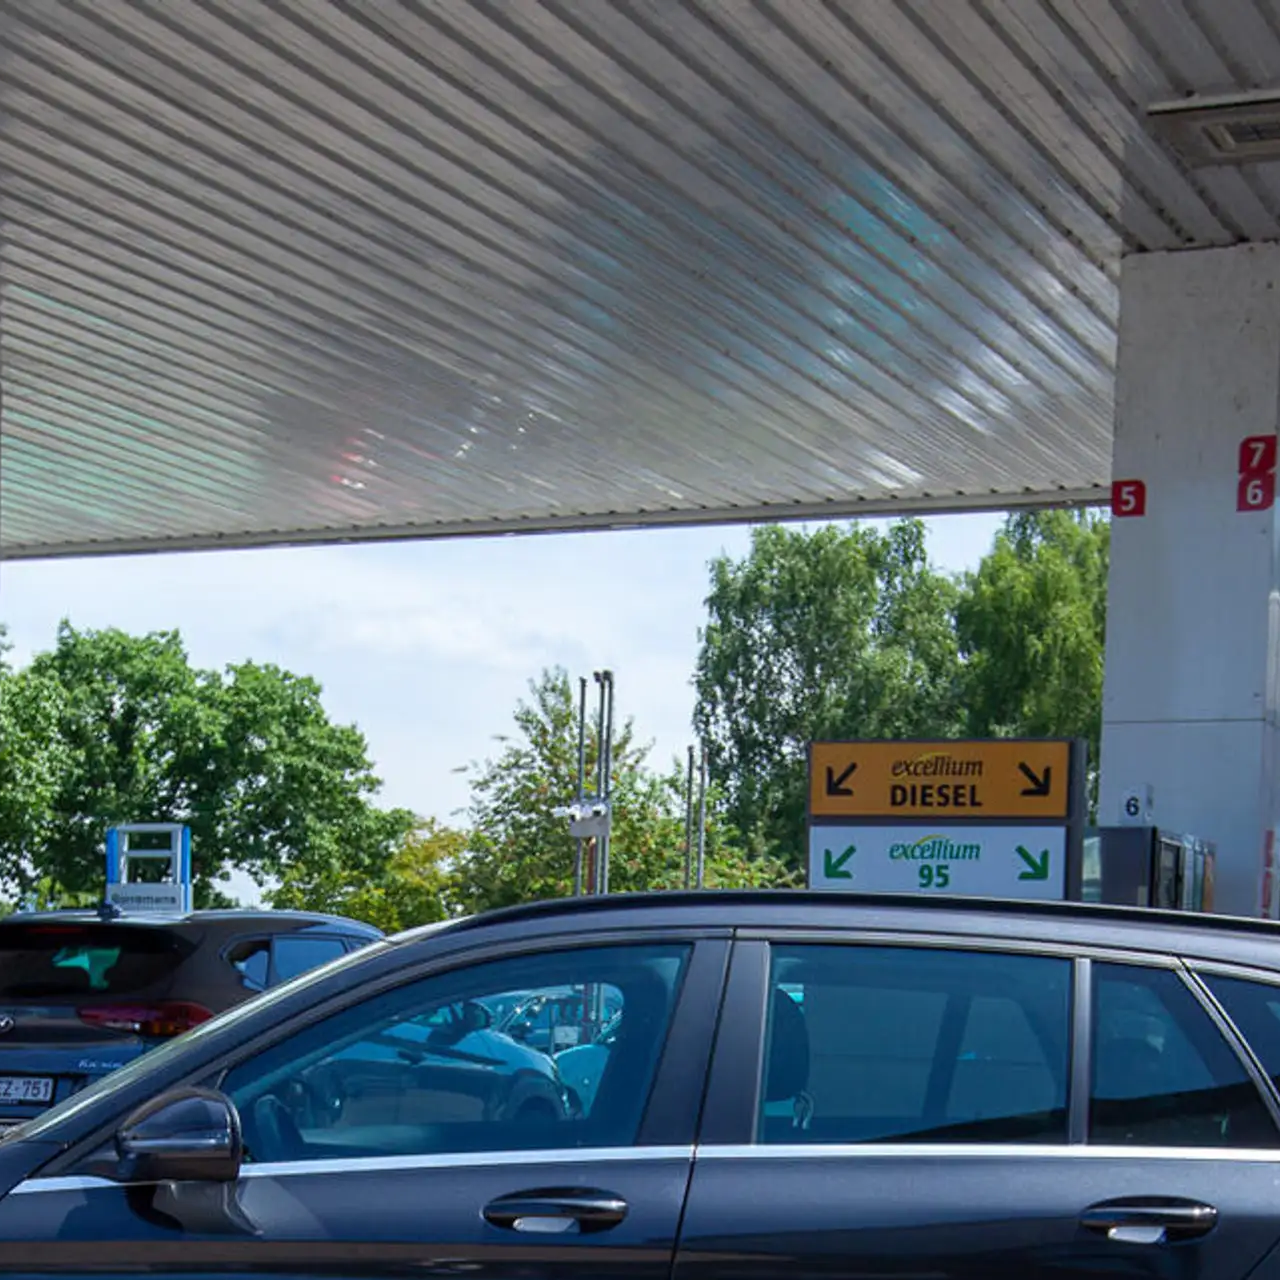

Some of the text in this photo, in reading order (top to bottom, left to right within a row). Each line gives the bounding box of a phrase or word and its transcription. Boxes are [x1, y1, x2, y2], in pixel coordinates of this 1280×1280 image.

[1249, 442, 1266, 467] 7
[1121, 486, 1136, 511] 5
[1246, 480, 1263, 505] 6
[891, 755, 984, 777] excellium
[890, 784, 984, 807] DIESEL
[1126, 796, 1140, 816] 6
[889, 838, 982, 861] excellium
[918, 864, 951, 888] 95
